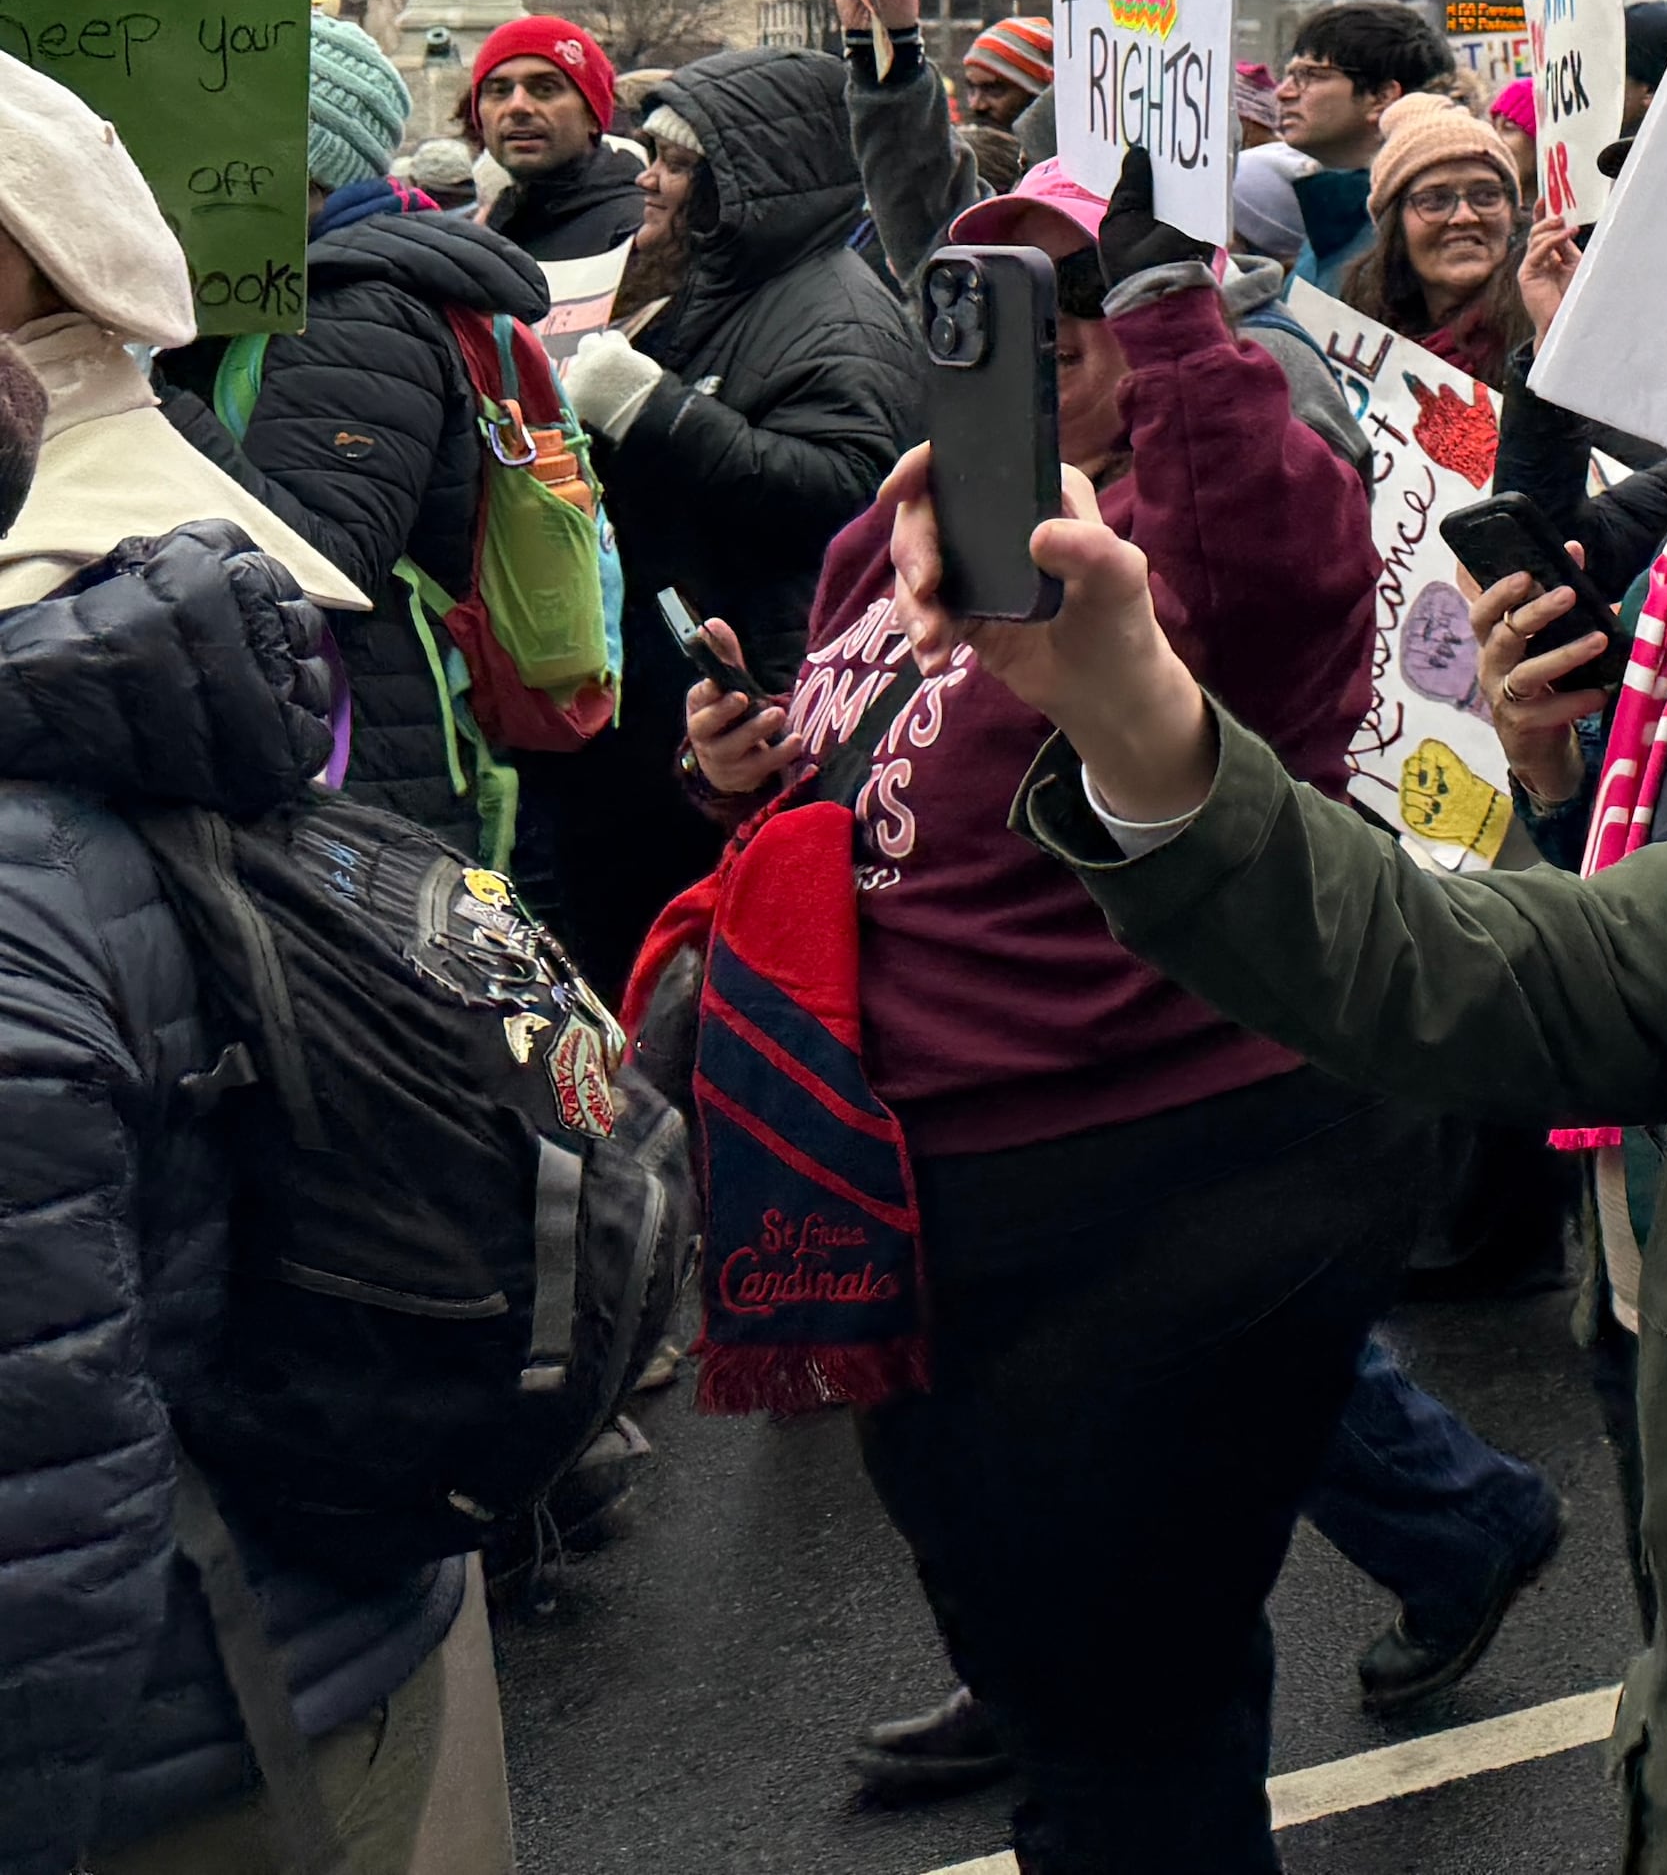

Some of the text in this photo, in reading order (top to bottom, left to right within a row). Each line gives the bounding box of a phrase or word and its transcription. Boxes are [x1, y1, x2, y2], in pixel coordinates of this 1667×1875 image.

[198, 15, 297, 93] your
[1089, 26, 1213, 170] RIGHTS!
[189, 260, 303, 317] ooks
